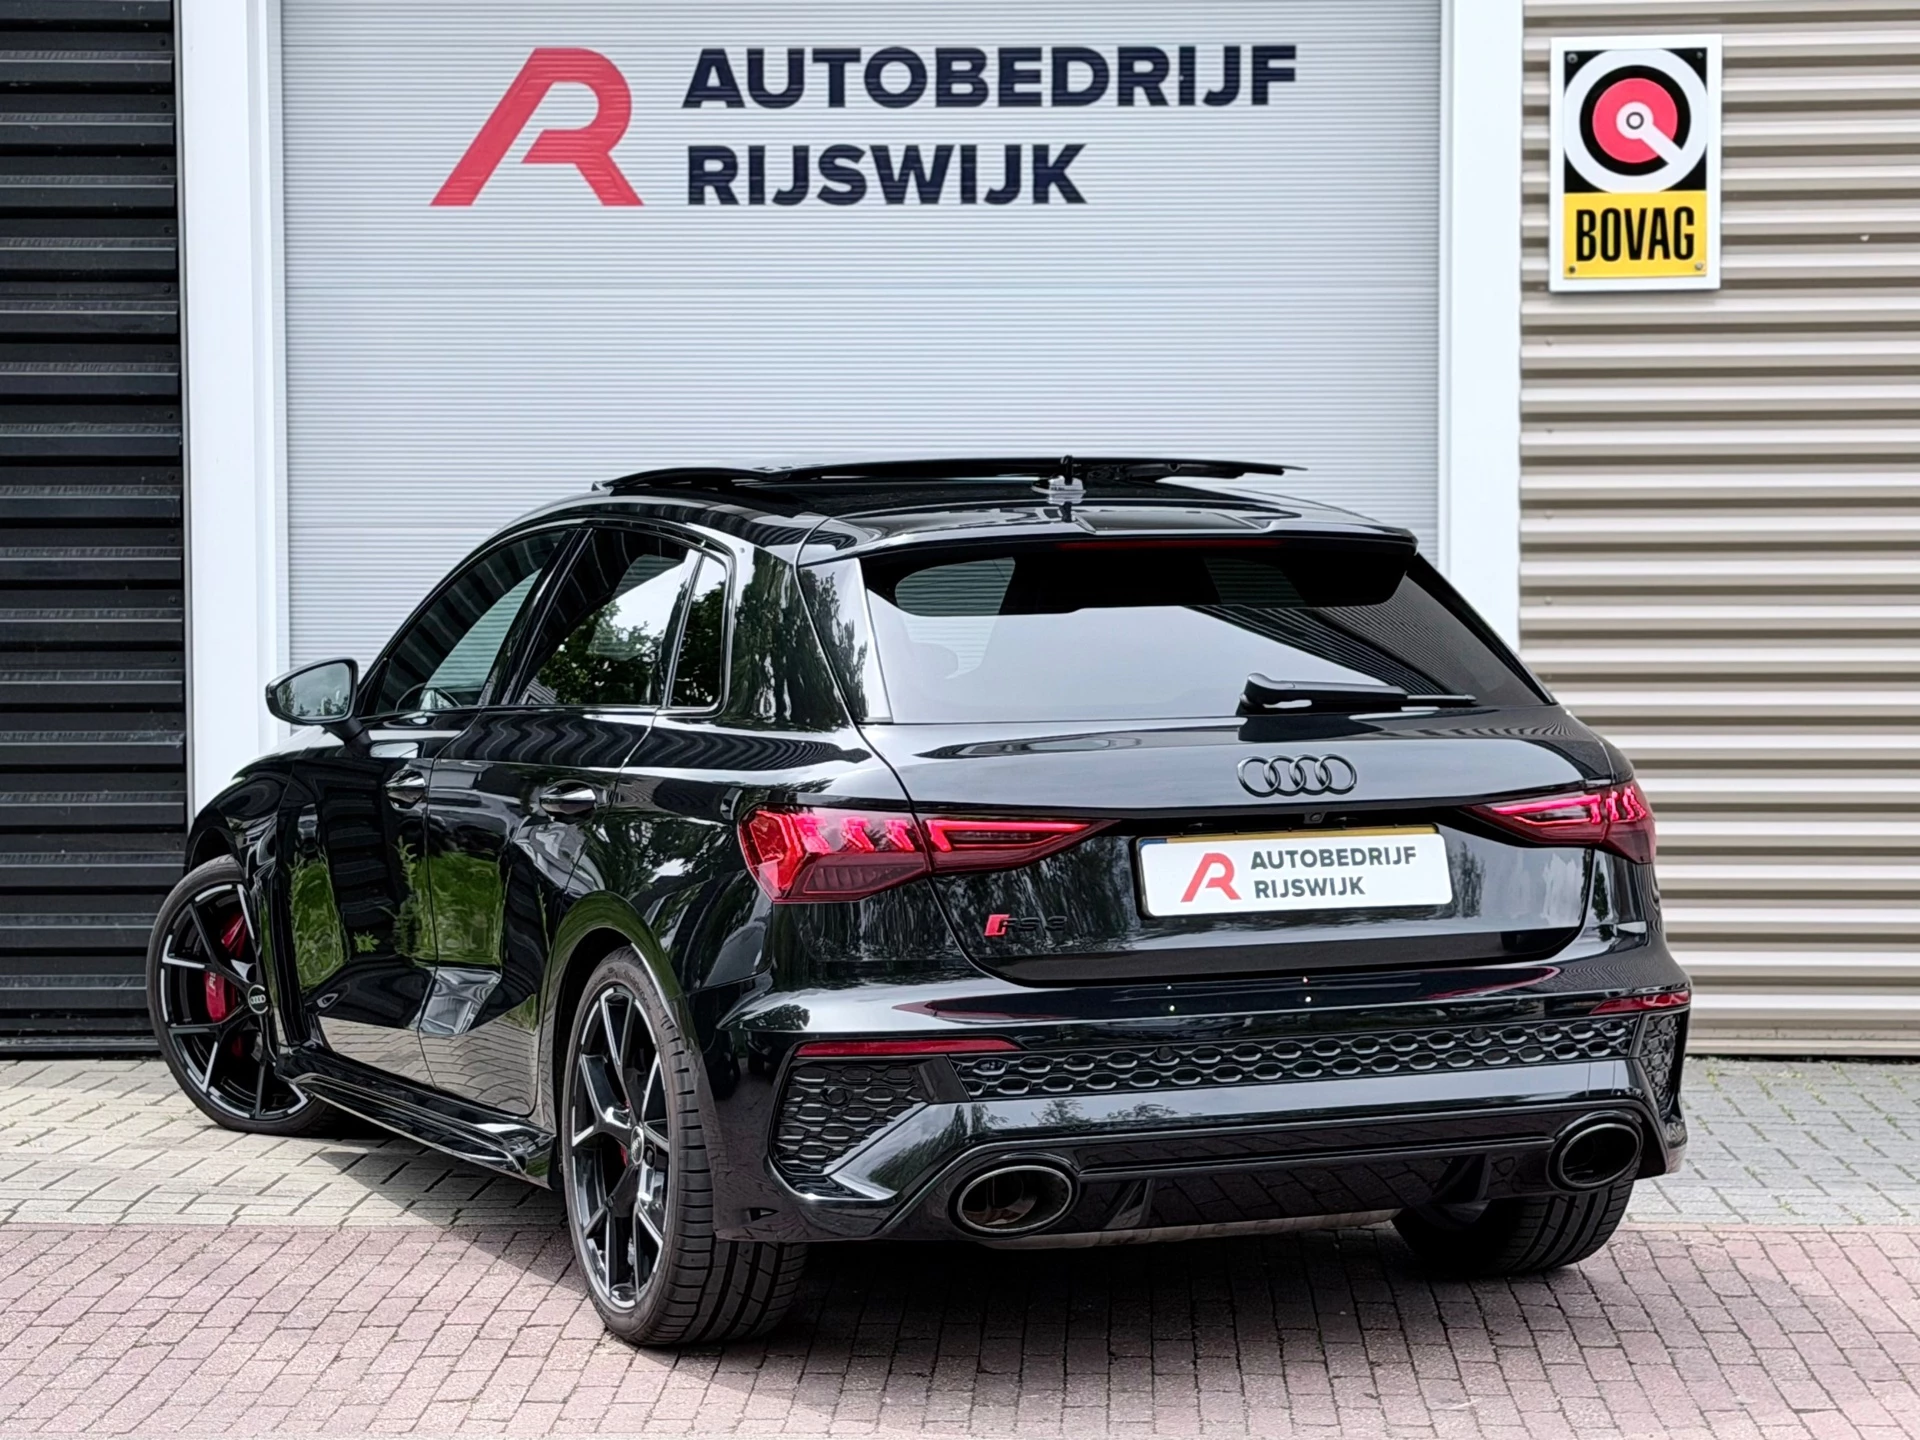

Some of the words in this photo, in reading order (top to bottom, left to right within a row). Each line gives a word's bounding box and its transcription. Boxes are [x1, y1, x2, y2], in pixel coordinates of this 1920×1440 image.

[682, 44, 1297, 109] AUTOBEDRIJF
[687, 143, 1087, 206] RIJSWIJK
[1576, 206, 1695, 262] BOVAG
[1250, 845, 1417, 870] AUTOBEDRIJF
[1253, 876, 1366, 899] RIJSWIJK
